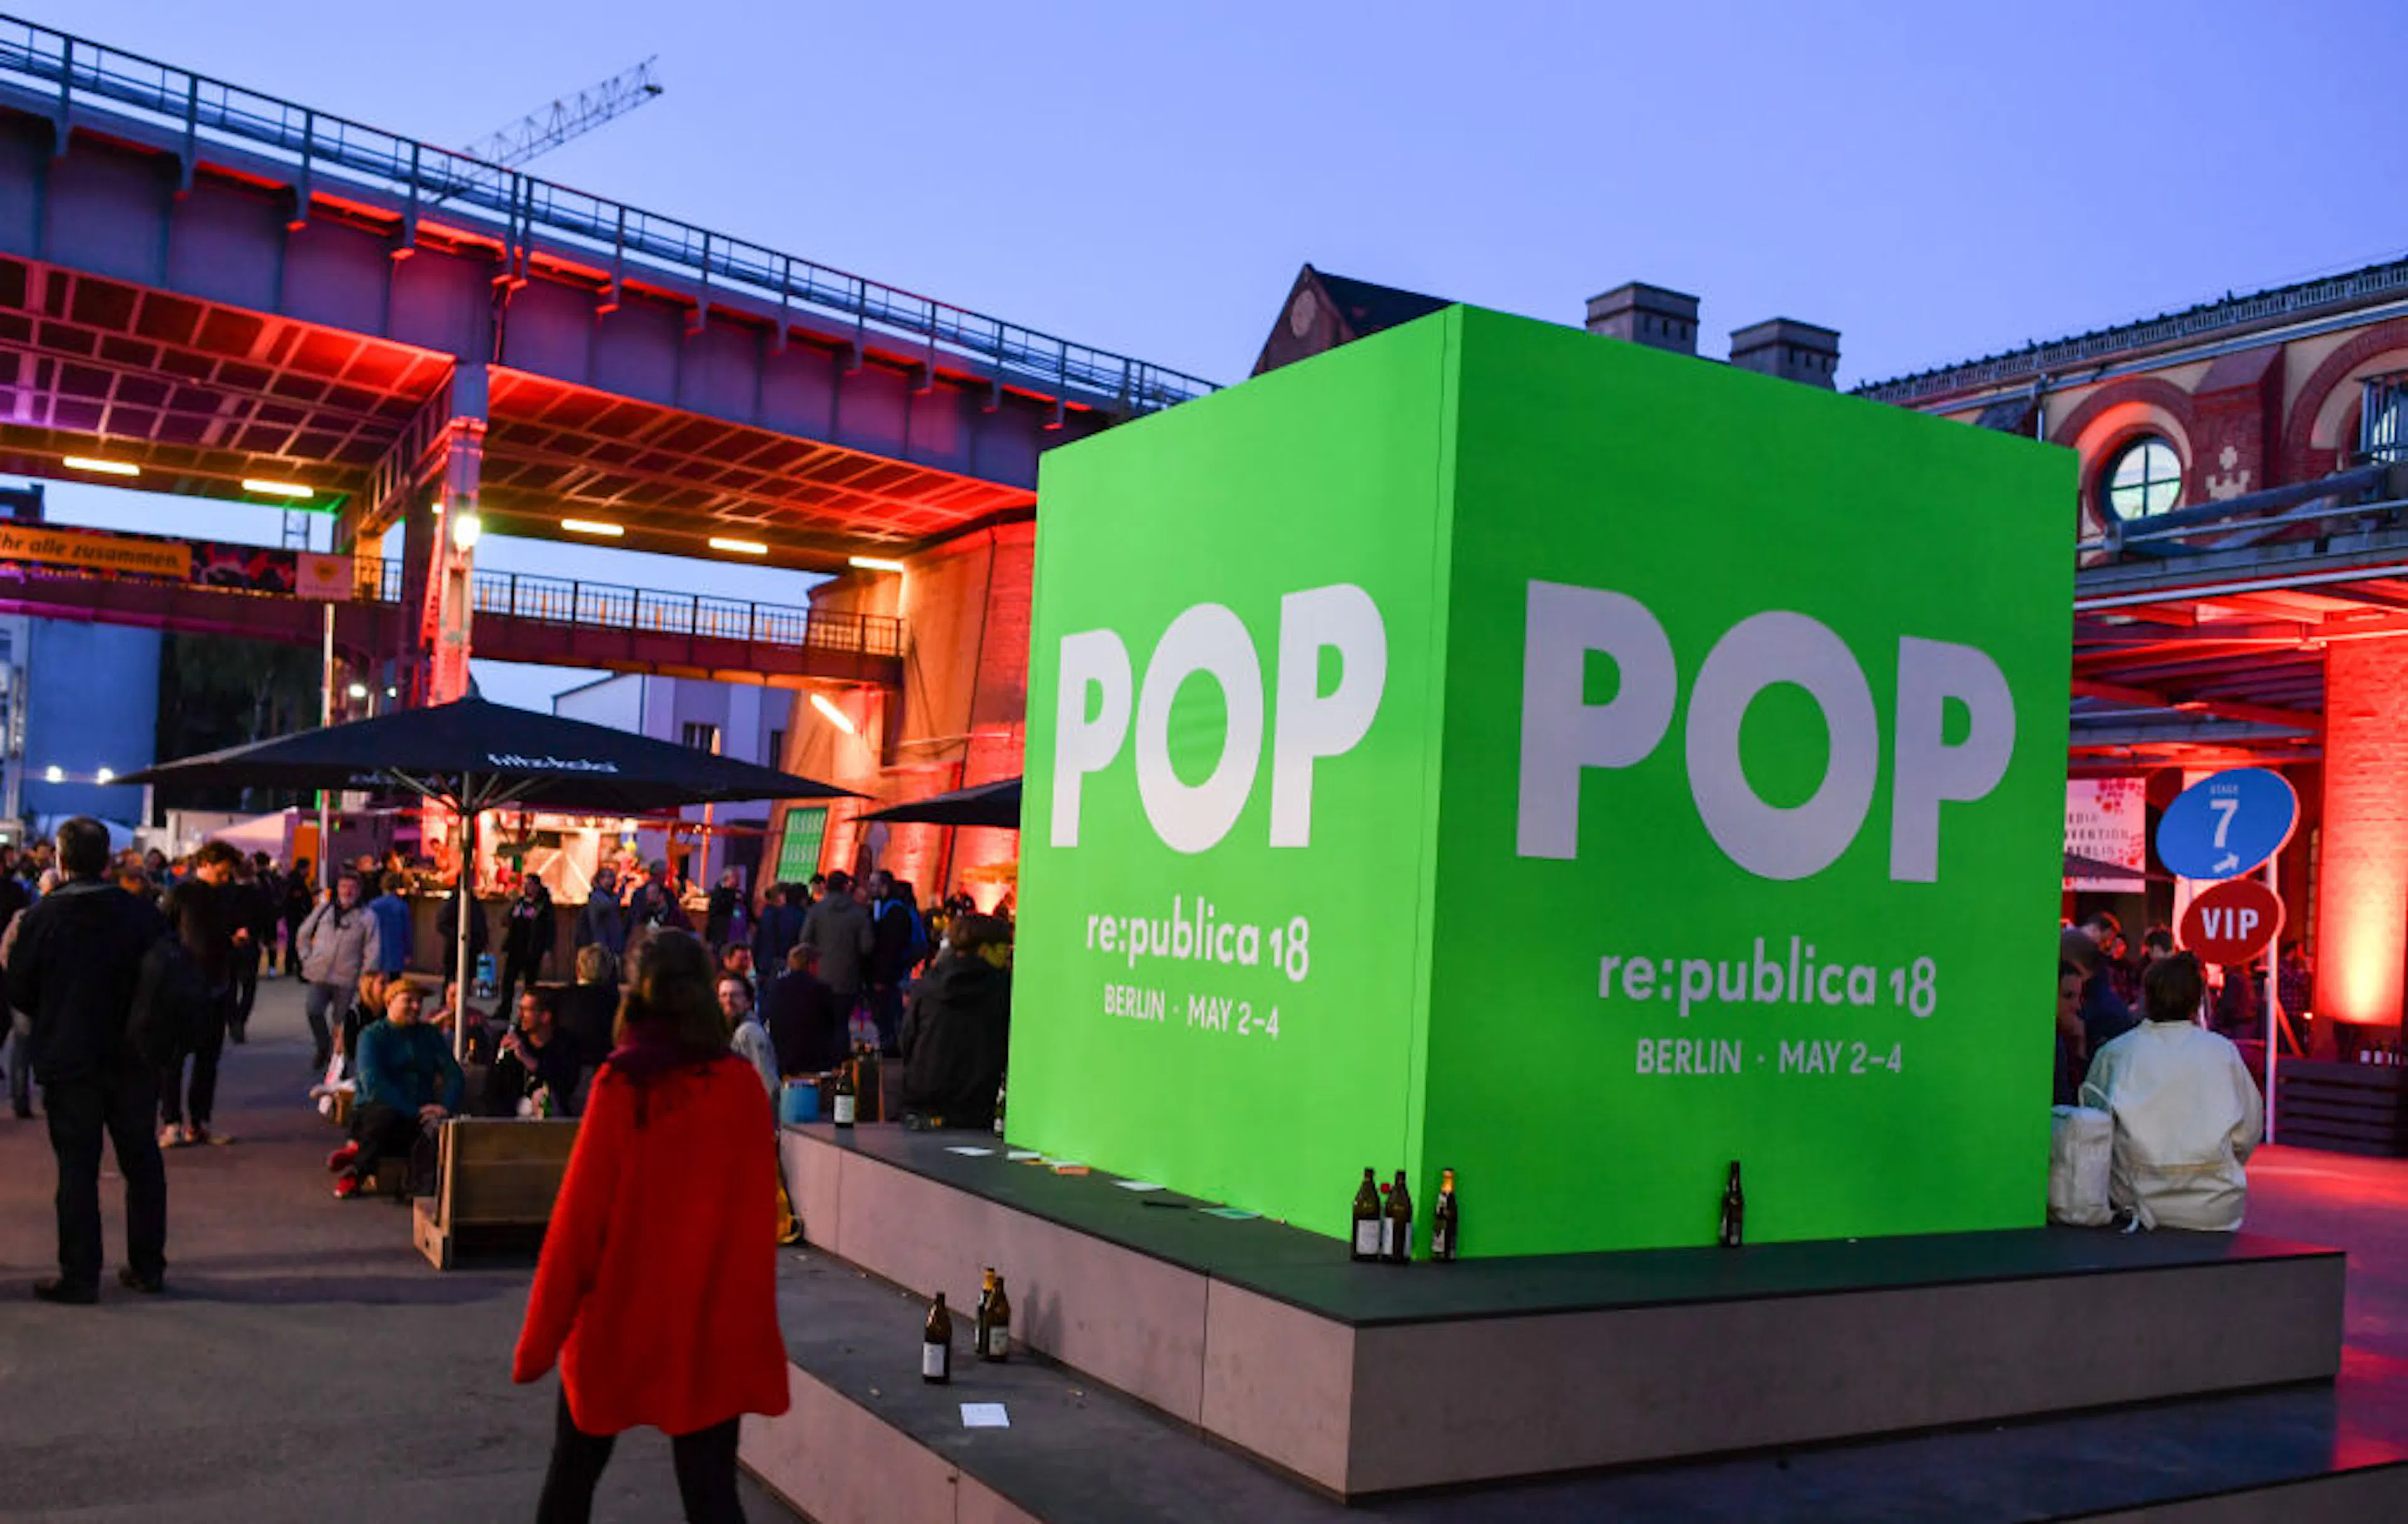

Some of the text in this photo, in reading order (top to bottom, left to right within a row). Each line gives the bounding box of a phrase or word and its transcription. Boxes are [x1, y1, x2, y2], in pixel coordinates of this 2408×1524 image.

[0, 531, 23, 550] hr
[29, 537, 66, 556] alle
[1050, 583, 1388, 854] POP
[1516, 579, 2017, 883] POP
[2210, 799, 2238, 848] 7
[1086, 894, 1309, 982] re:publica 18
[2201, 908, 2259, 940] VIP
[1598, 935, 1937, 1018] re:publica 18
[1104, 983, 1166, 1022] BERLIN
[1187, 995, 1233, 1033] MAY
[1635, 1037, 1742, 1074] BERLIN
[1778, 1039, 1844, 1074] MAY
